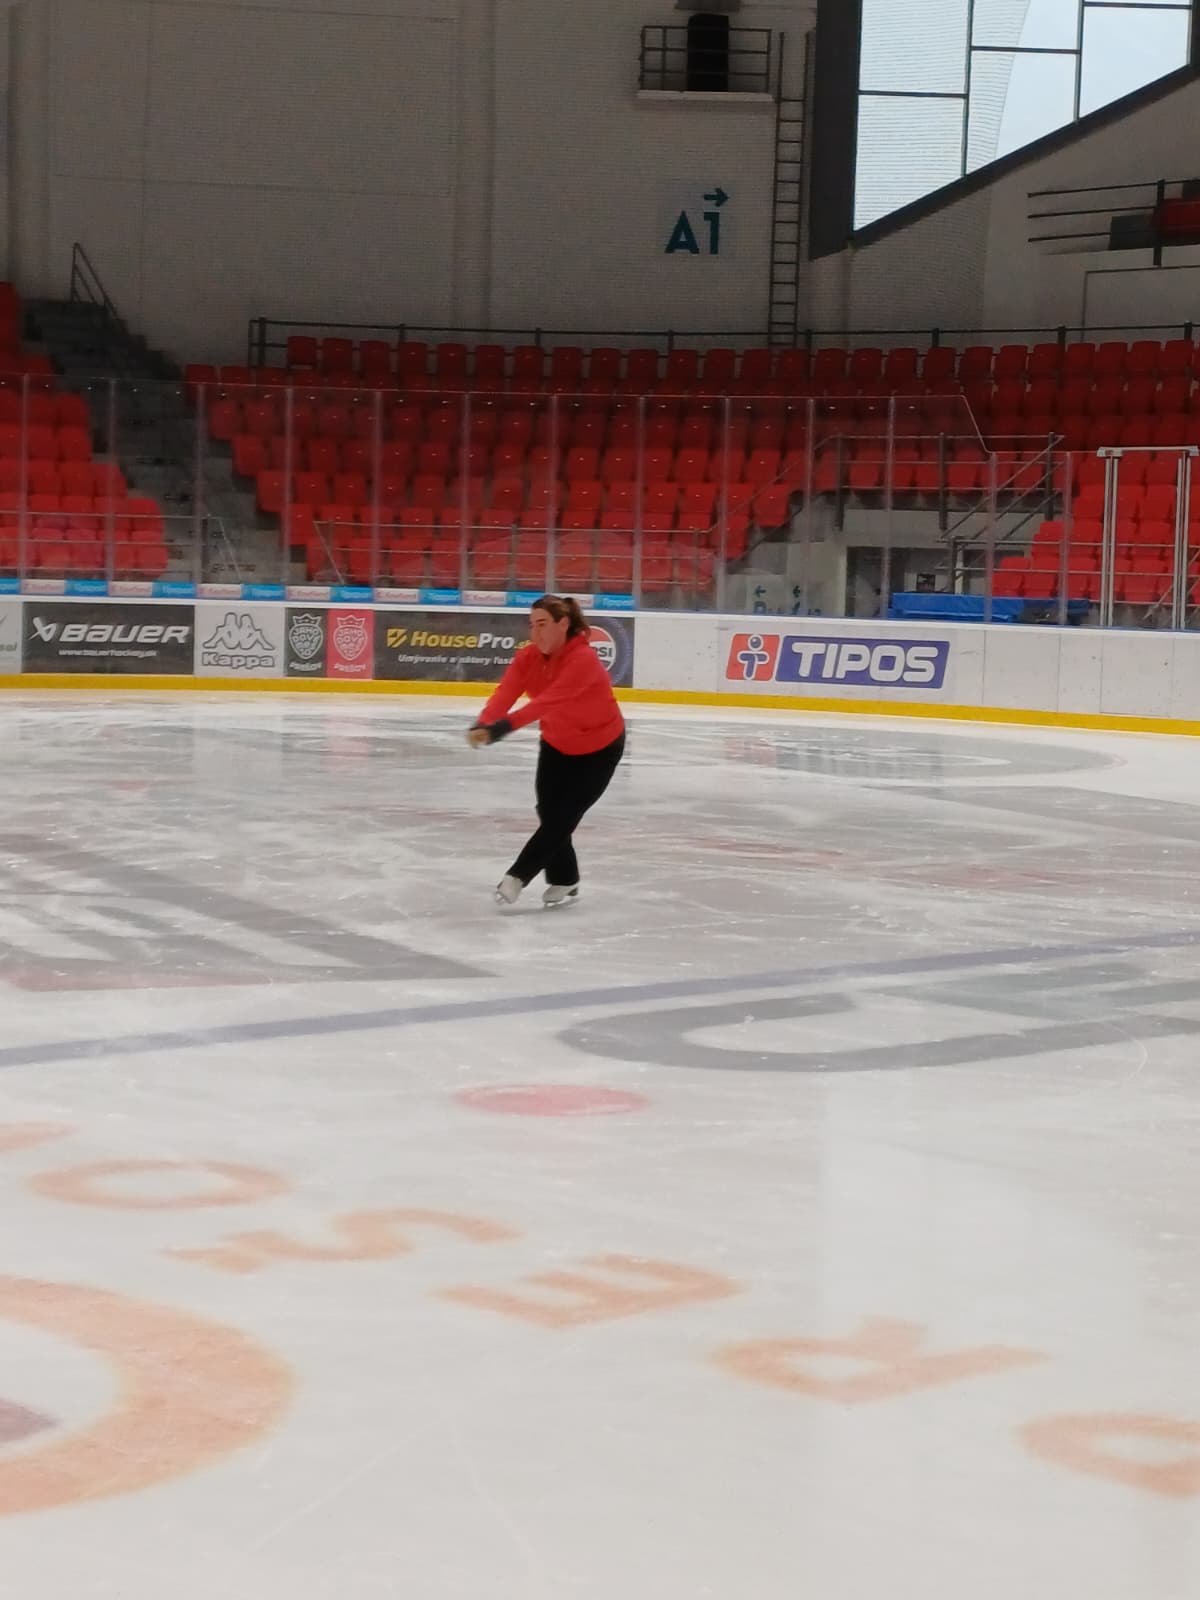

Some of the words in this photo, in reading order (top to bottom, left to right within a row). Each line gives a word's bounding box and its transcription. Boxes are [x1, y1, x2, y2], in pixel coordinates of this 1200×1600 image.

[664, 210, 720, 255] A1
[201, 651, 275, 670] Kappa
[791, 642, 939, 683] TIPOS
